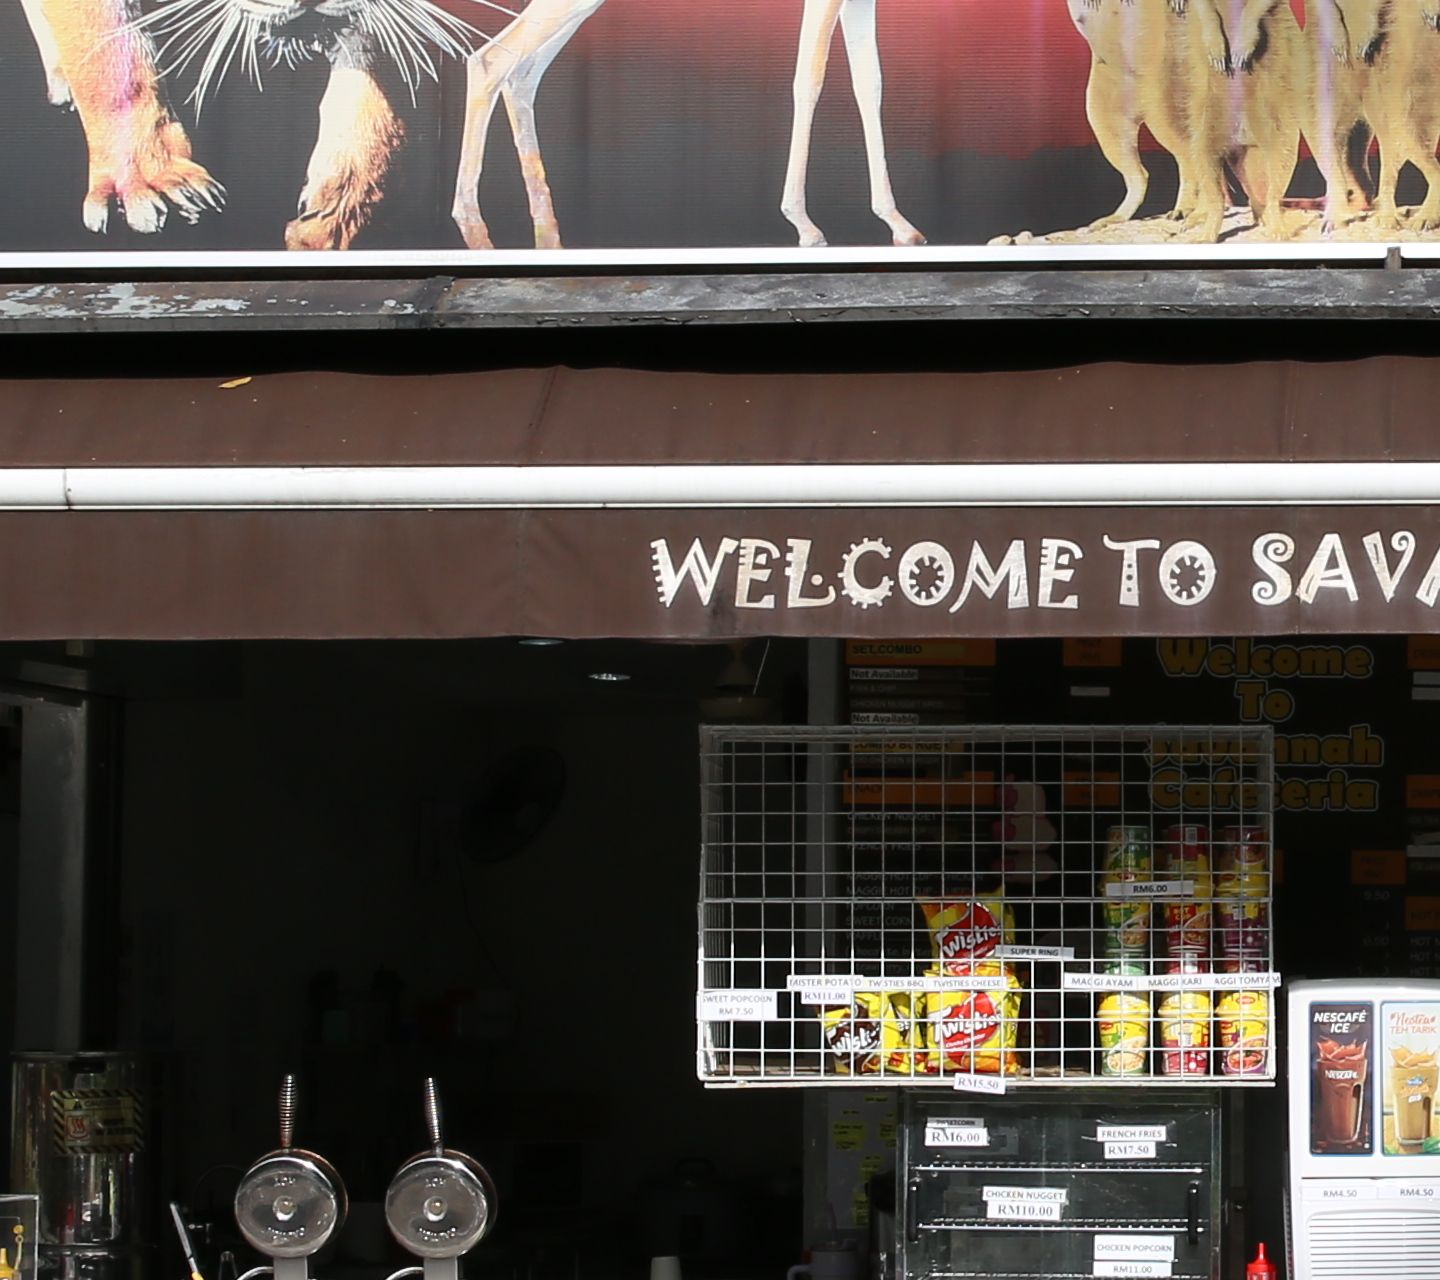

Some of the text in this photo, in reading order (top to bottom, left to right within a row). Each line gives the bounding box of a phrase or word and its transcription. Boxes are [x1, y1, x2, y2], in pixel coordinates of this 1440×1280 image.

[649, 535, 1084, 614] WELCOME
[1103, 532, 1218, 608] TO
[1155, 637, 1375, 678] Welcome
[1234, 679, 1296, 723] To
[1148, 767, 1380, 812] Cafeteria
[1132, 883, 1168, 894] RM6.00
[1010, 948, 1059, 958] SUPER RING
[970, 979, 1003, 988] CHEESE
[1106, 978, 1134, 987] AYAM
[1148, 977, 1179, 987] MAGGI
[730, 995, 773, 1005] POPCORN
[804, 991, 847, 1003] RM11.00
[719, 1007, 754, 1016] RM 7.50
[1313, 1009, 1367, 1023] NESCAFÉ
[1330, 1023, 1351, 1034] ICE
[1390, 1025, 1436, 1035] TEH TARIK
[957, 1077, 1000, 1091] RM5.50
[931, 1129, 980, 1144] RM6.00
[1101, 1129, 1162, 1139] FRENCH FRIES
[1107, 1144, 1150, 1156] RM7.50
[985, 1189, 1064, 1201] CHICKEN NUGGET
[1323, 1189, 1358, 1198] RM4.50
[1399, 1188, 1434, 1197] RM4.50
[997, 1205, 1053, 1217] RM10.00
[1096, 1243, 1173, 1253] CHICKEN POPCORN
[1112, 1265, 1153, 1275] RM11.00
